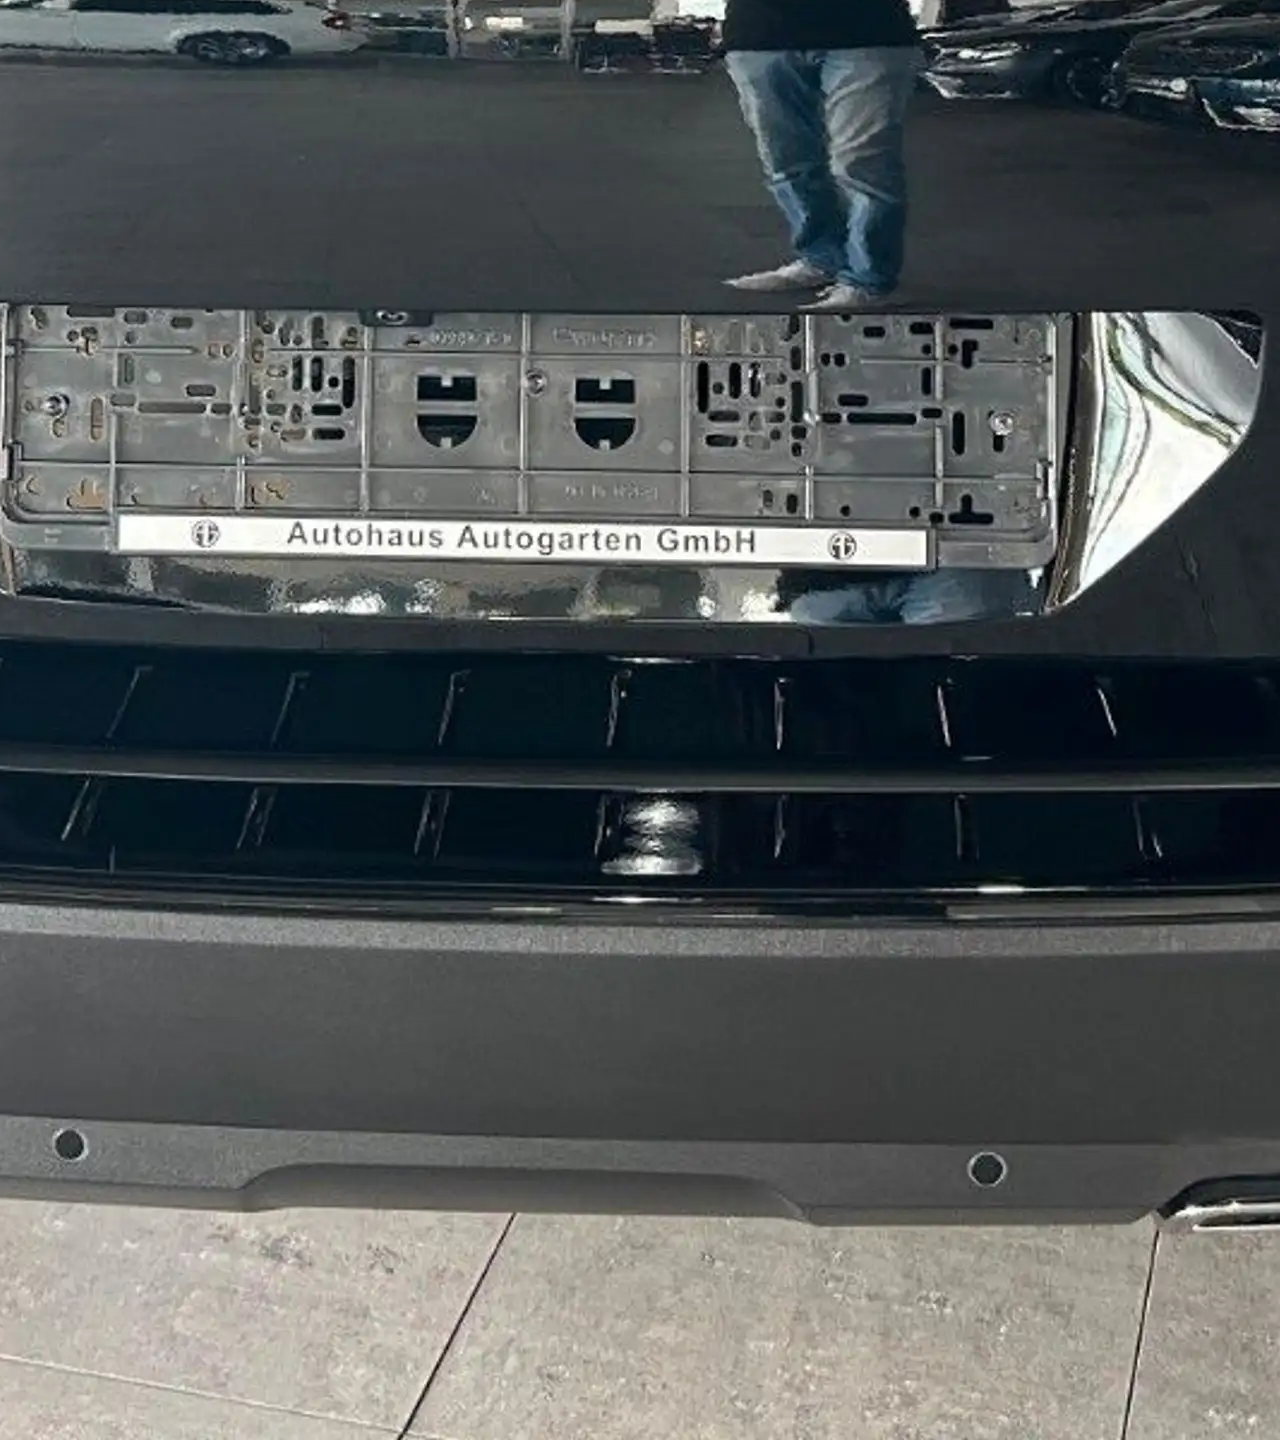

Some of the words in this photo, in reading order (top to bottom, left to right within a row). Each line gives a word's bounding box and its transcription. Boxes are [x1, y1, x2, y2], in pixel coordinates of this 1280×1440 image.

[286, 521, 444, 548] Autohaus
[457, 524, 643, 557] Autogarten
[657, 528, 758, 555] GmbH
